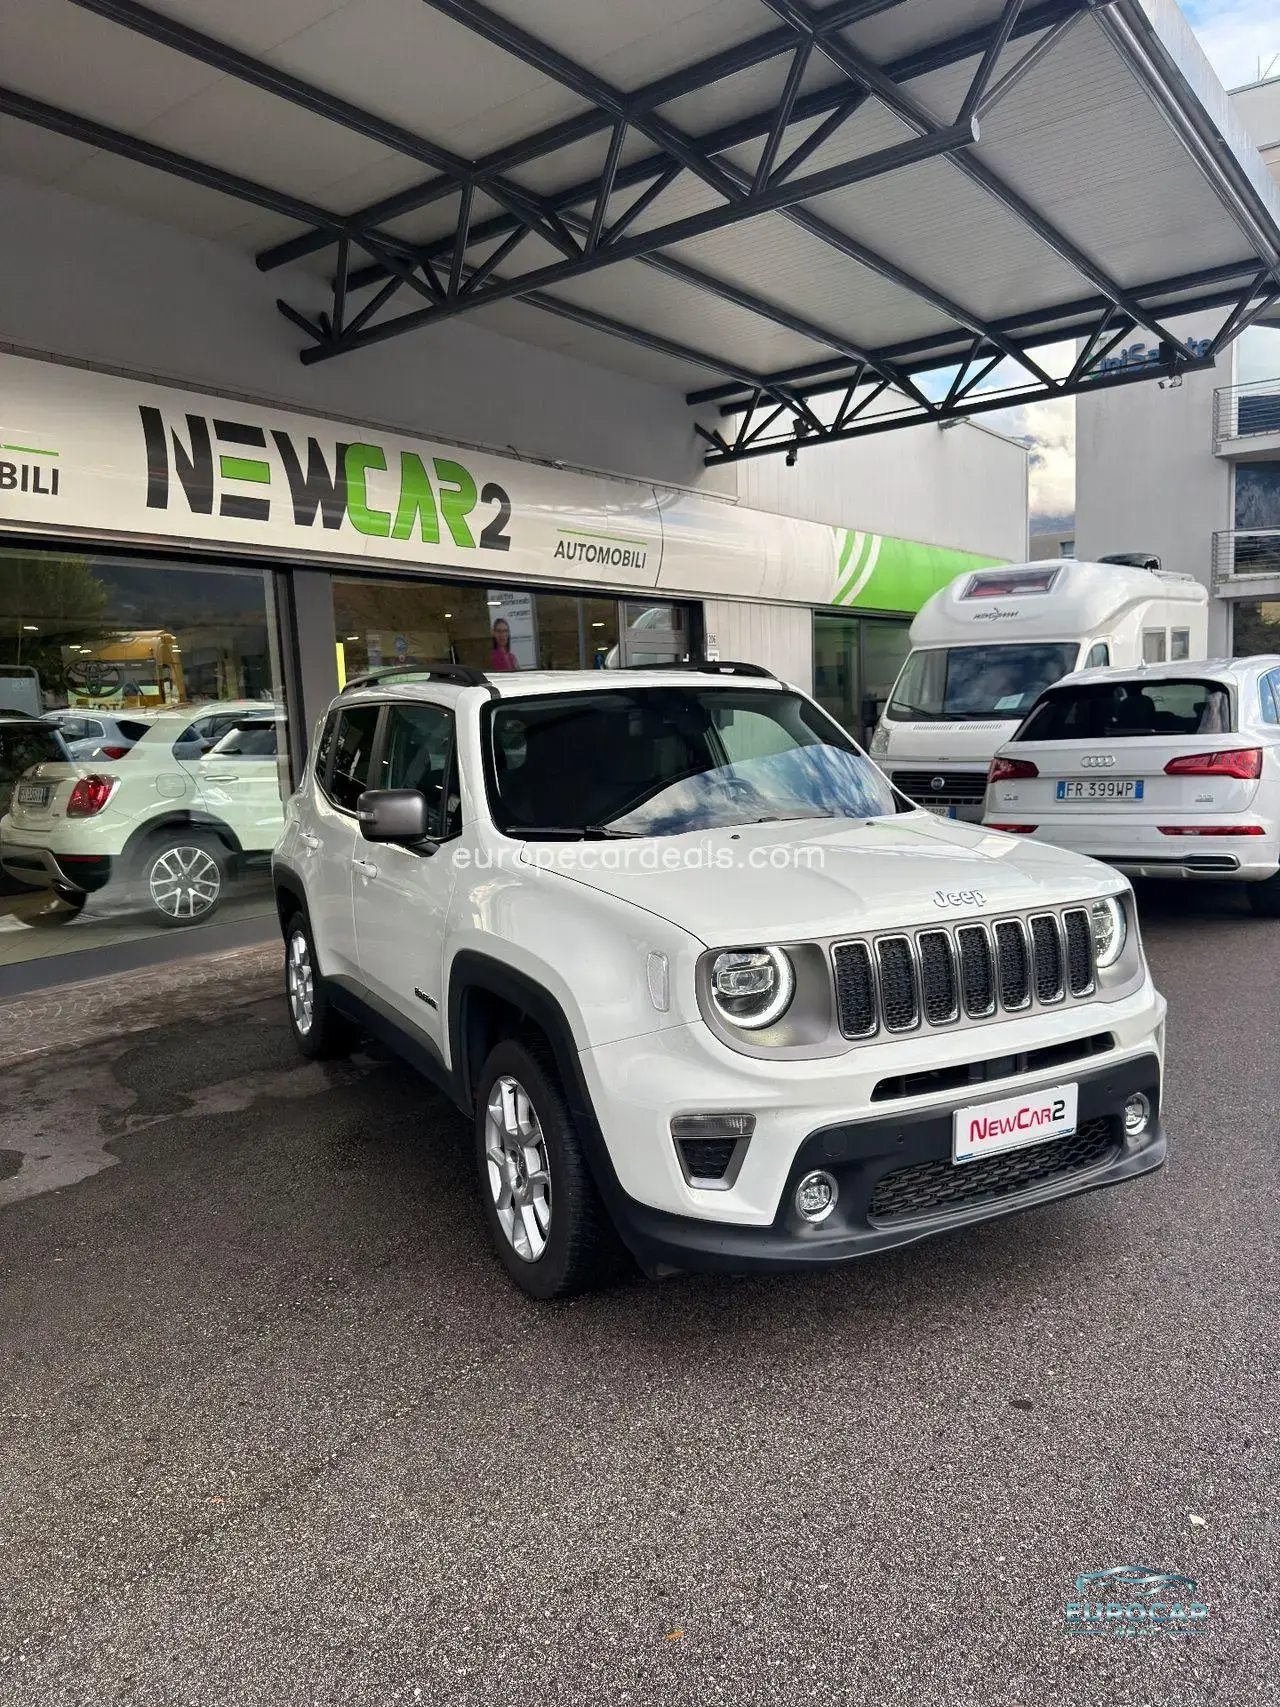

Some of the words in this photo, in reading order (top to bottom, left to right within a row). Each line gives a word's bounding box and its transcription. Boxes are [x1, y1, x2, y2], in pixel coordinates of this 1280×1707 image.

[554, 539, 647, 570] AUTOMOBILI
[1066, 782, 1083, 797] FR
[1088, 782, 1134, 797] 399WP
[933, 888, 988, 908] Jeep
